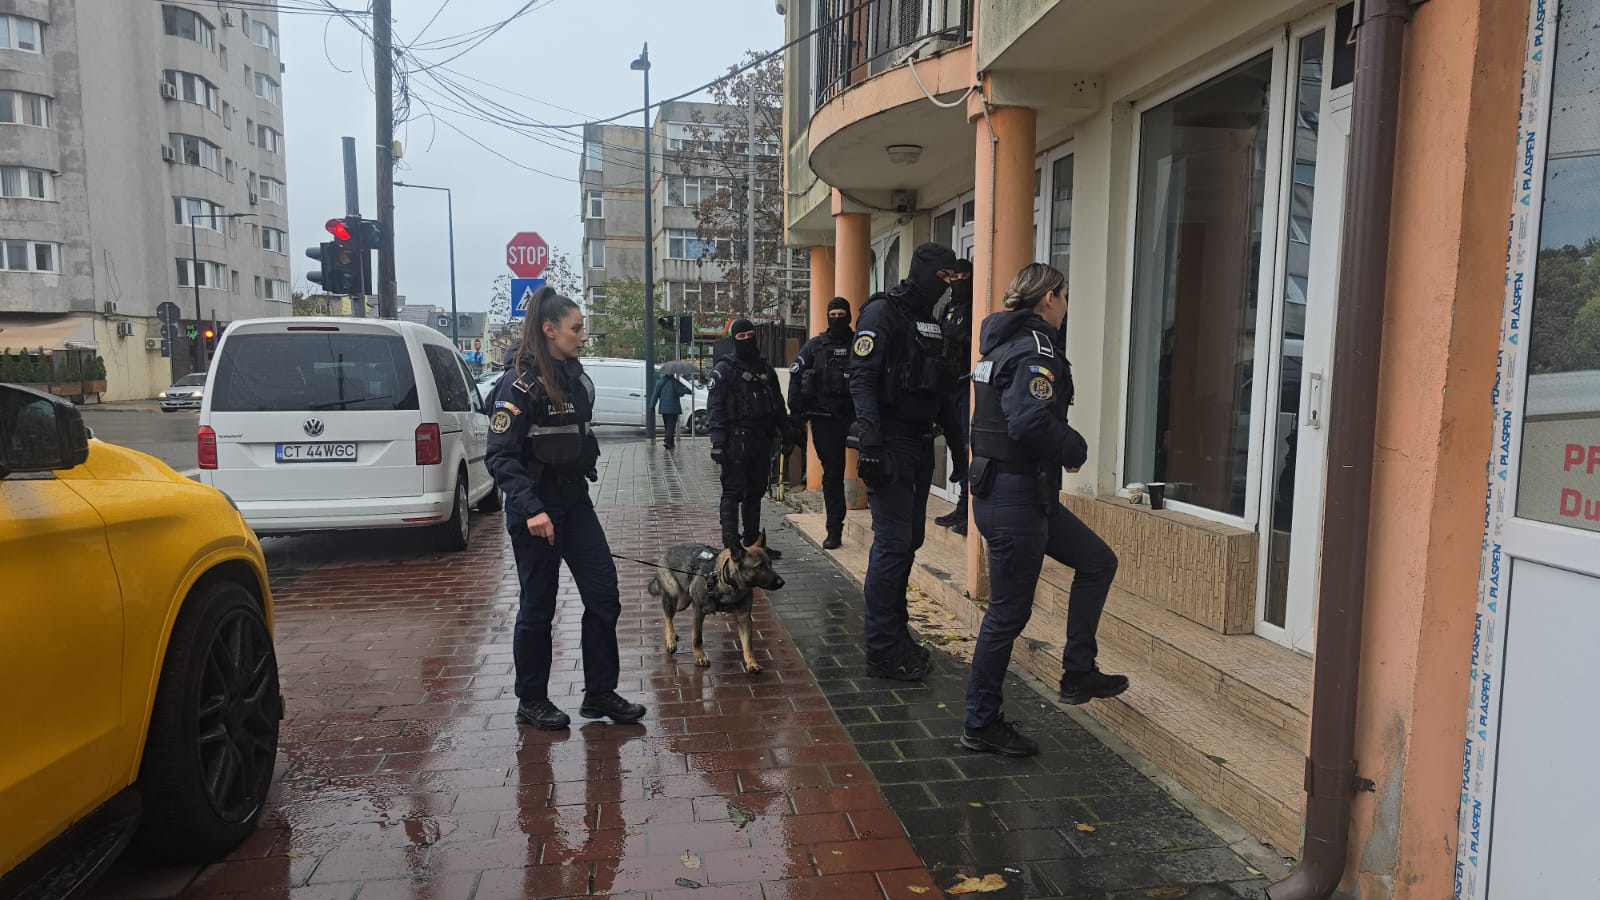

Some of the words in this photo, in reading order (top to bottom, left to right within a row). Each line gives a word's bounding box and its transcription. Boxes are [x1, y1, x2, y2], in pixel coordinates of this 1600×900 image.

[1523, 131, 1536, 191] PLASPEN
[508, 246, 547, 265] STOP
[1511, 272, 1524, 330] PLASPEN
[284, 445, 302, 458] CT
[1500, 410, 1512, 466] PLASPEN
[1560, 487, 1600, 521] Du
[1490, 543, 1502, 599] PLASPEN
[1480, 672, 1491, 727] PLASPEN
[1470, 799, 1482, 854] PLASPEN
